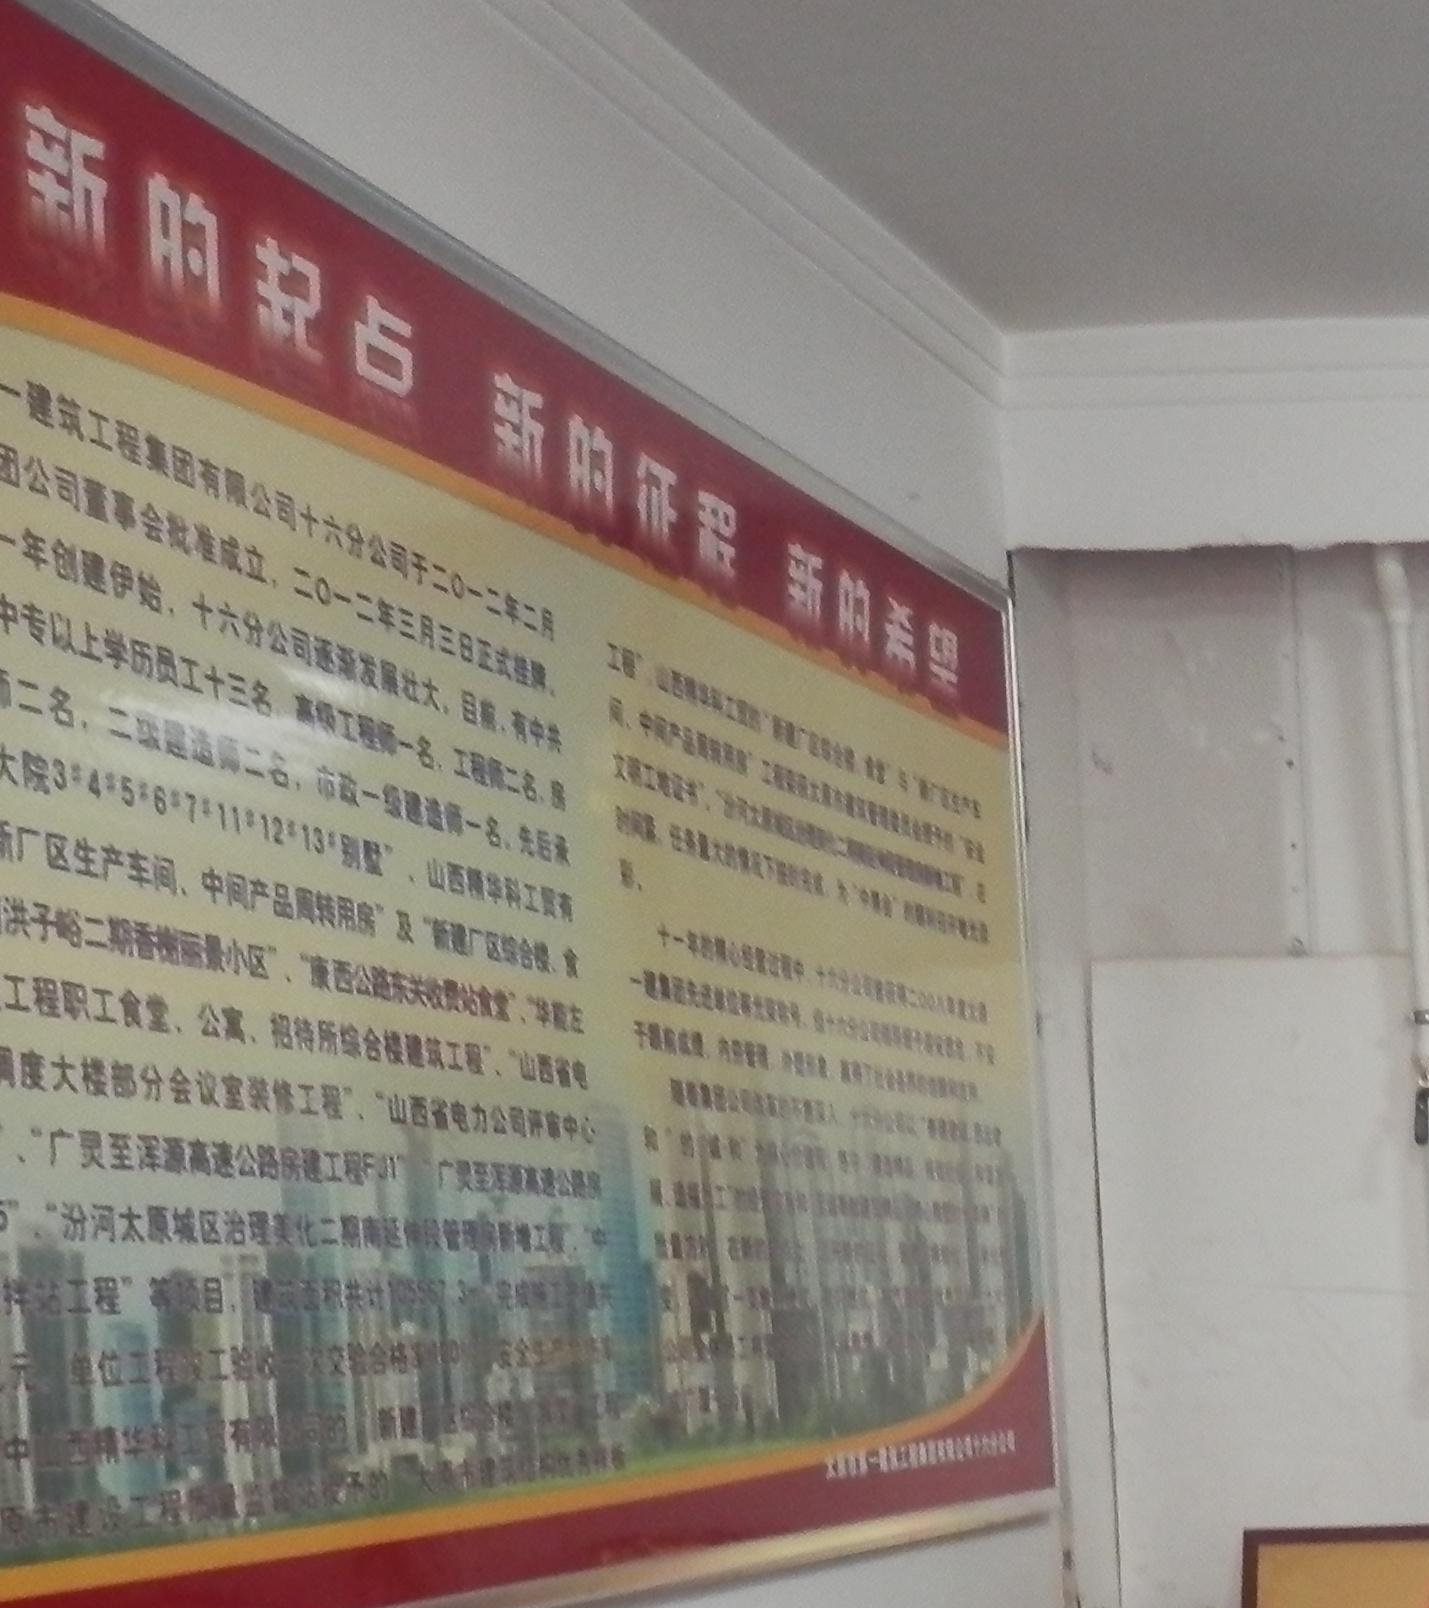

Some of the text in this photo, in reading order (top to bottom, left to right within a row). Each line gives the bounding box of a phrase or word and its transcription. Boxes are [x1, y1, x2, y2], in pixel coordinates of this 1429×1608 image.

[492, 372, 738, 580] 新的征程
[786, 543, 959, 693] 新的希望
